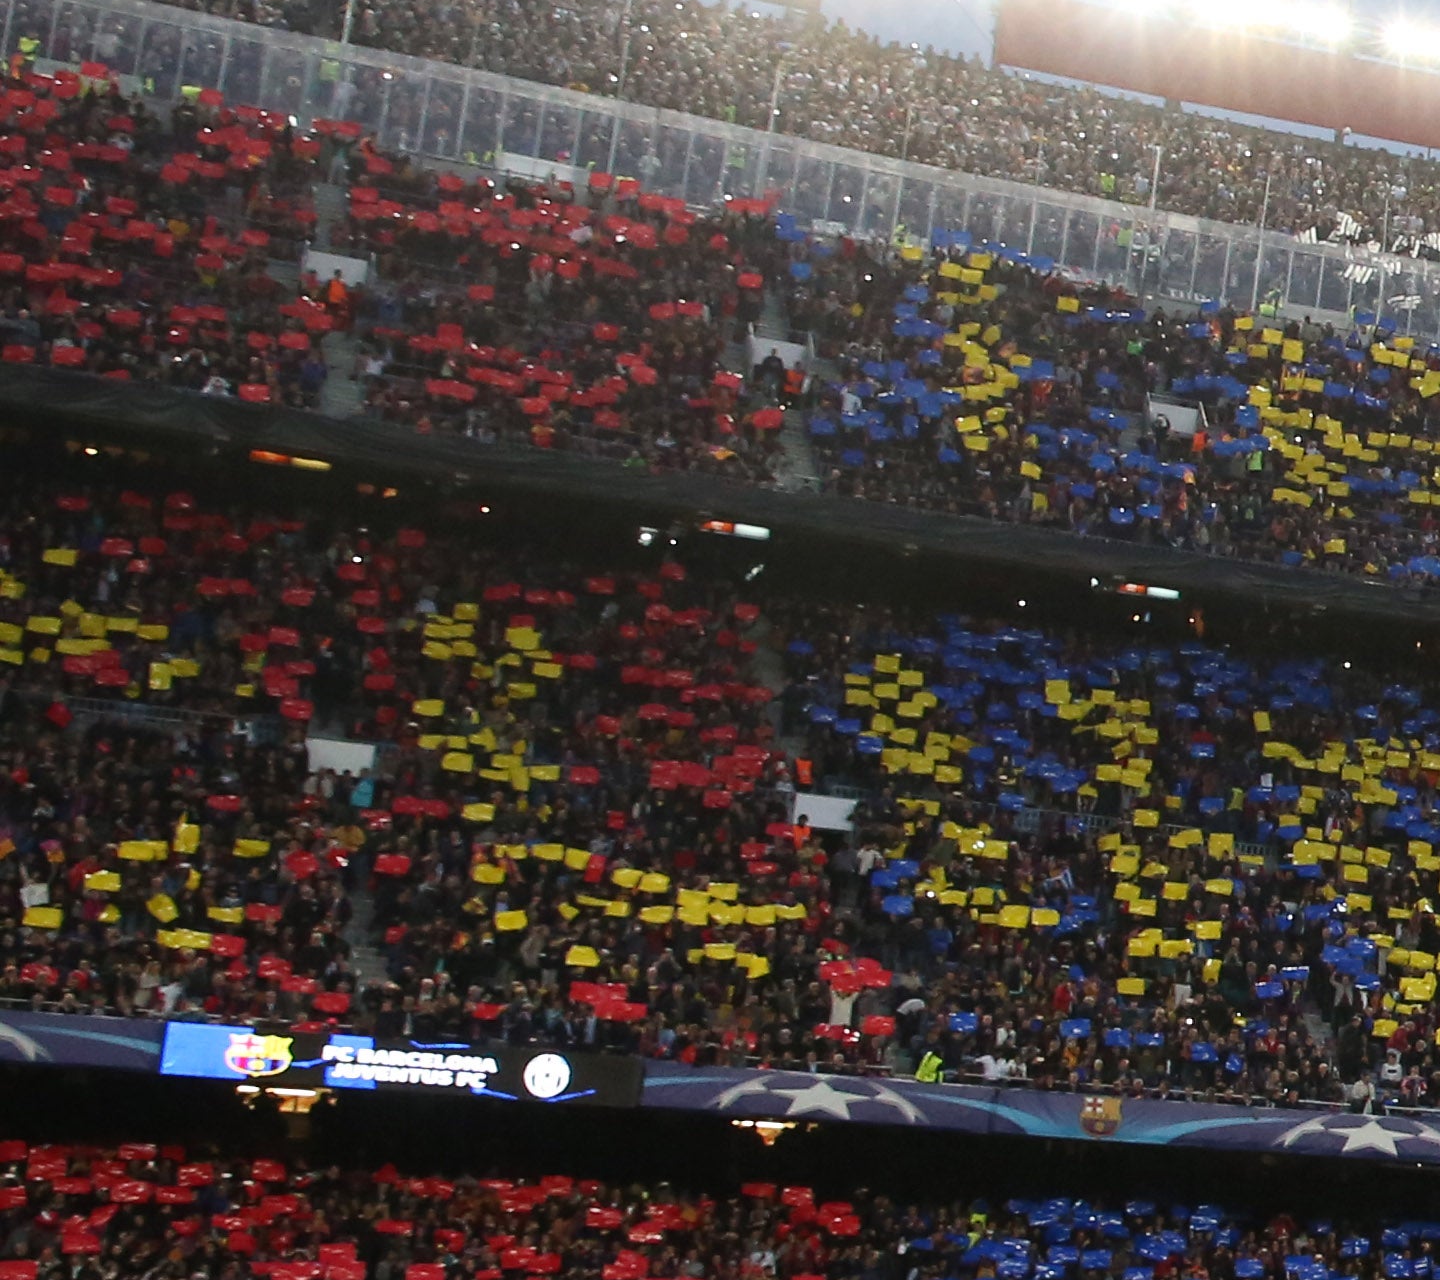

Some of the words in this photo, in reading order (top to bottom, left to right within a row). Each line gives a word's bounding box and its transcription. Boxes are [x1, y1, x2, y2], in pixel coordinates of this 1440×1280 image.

[322, 1045, 354, 1063] FC
[356, 1047, 498, 1073] BARCELONA
[330, 1062, 454, 1087] JUVENTUS
[455, 1072, 487, 1089] FC
